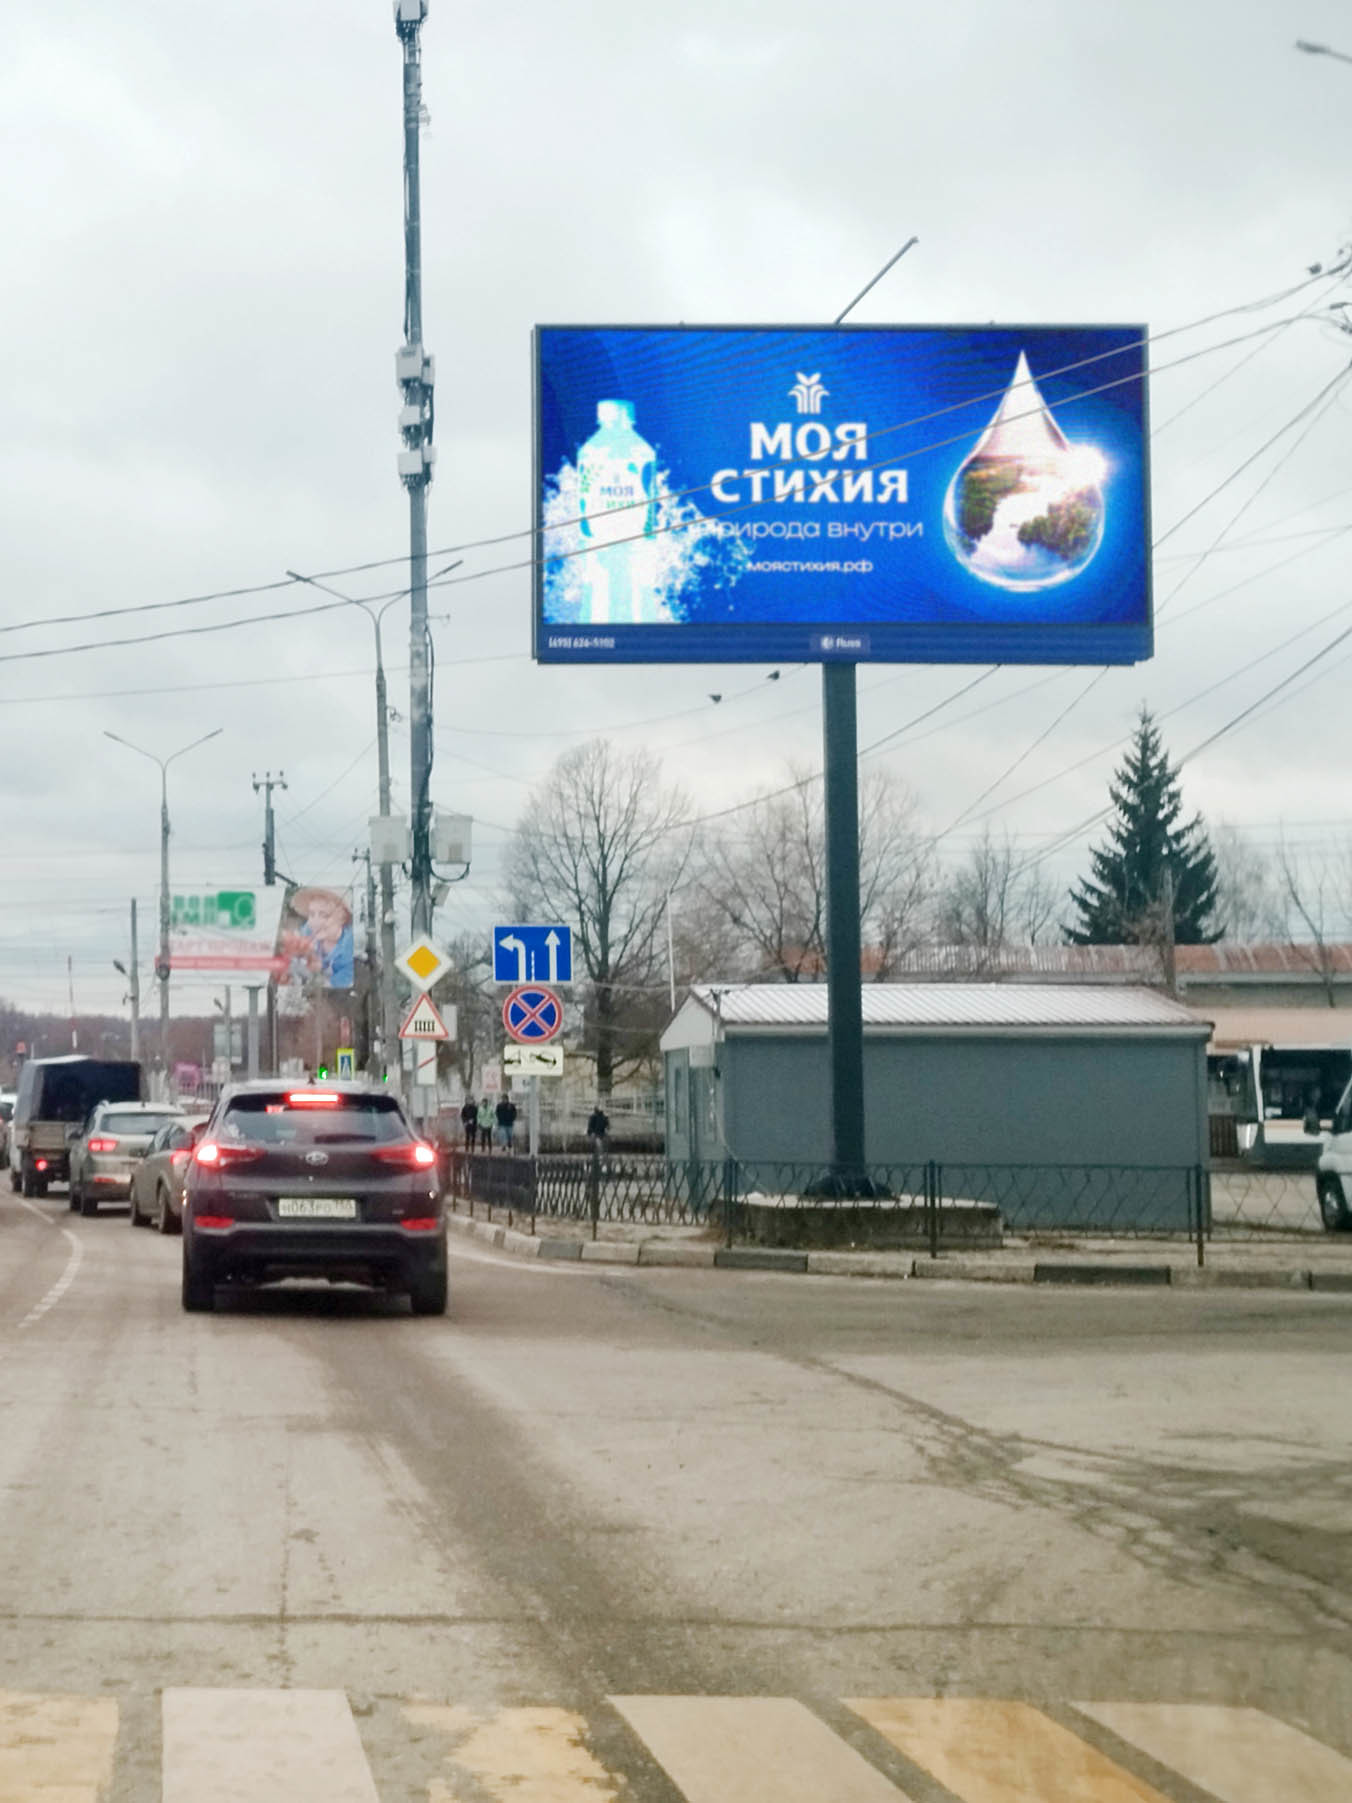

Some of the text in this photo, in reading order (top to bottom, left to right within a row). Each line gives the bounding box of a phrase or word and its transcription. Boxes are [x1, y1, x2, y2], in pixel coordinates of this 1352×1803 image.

[750, 422, 867, 461] МОЯ
[710, 468, 908, 503] СТИХИЯ
[701, 521, 924, 541] рирода внутри
